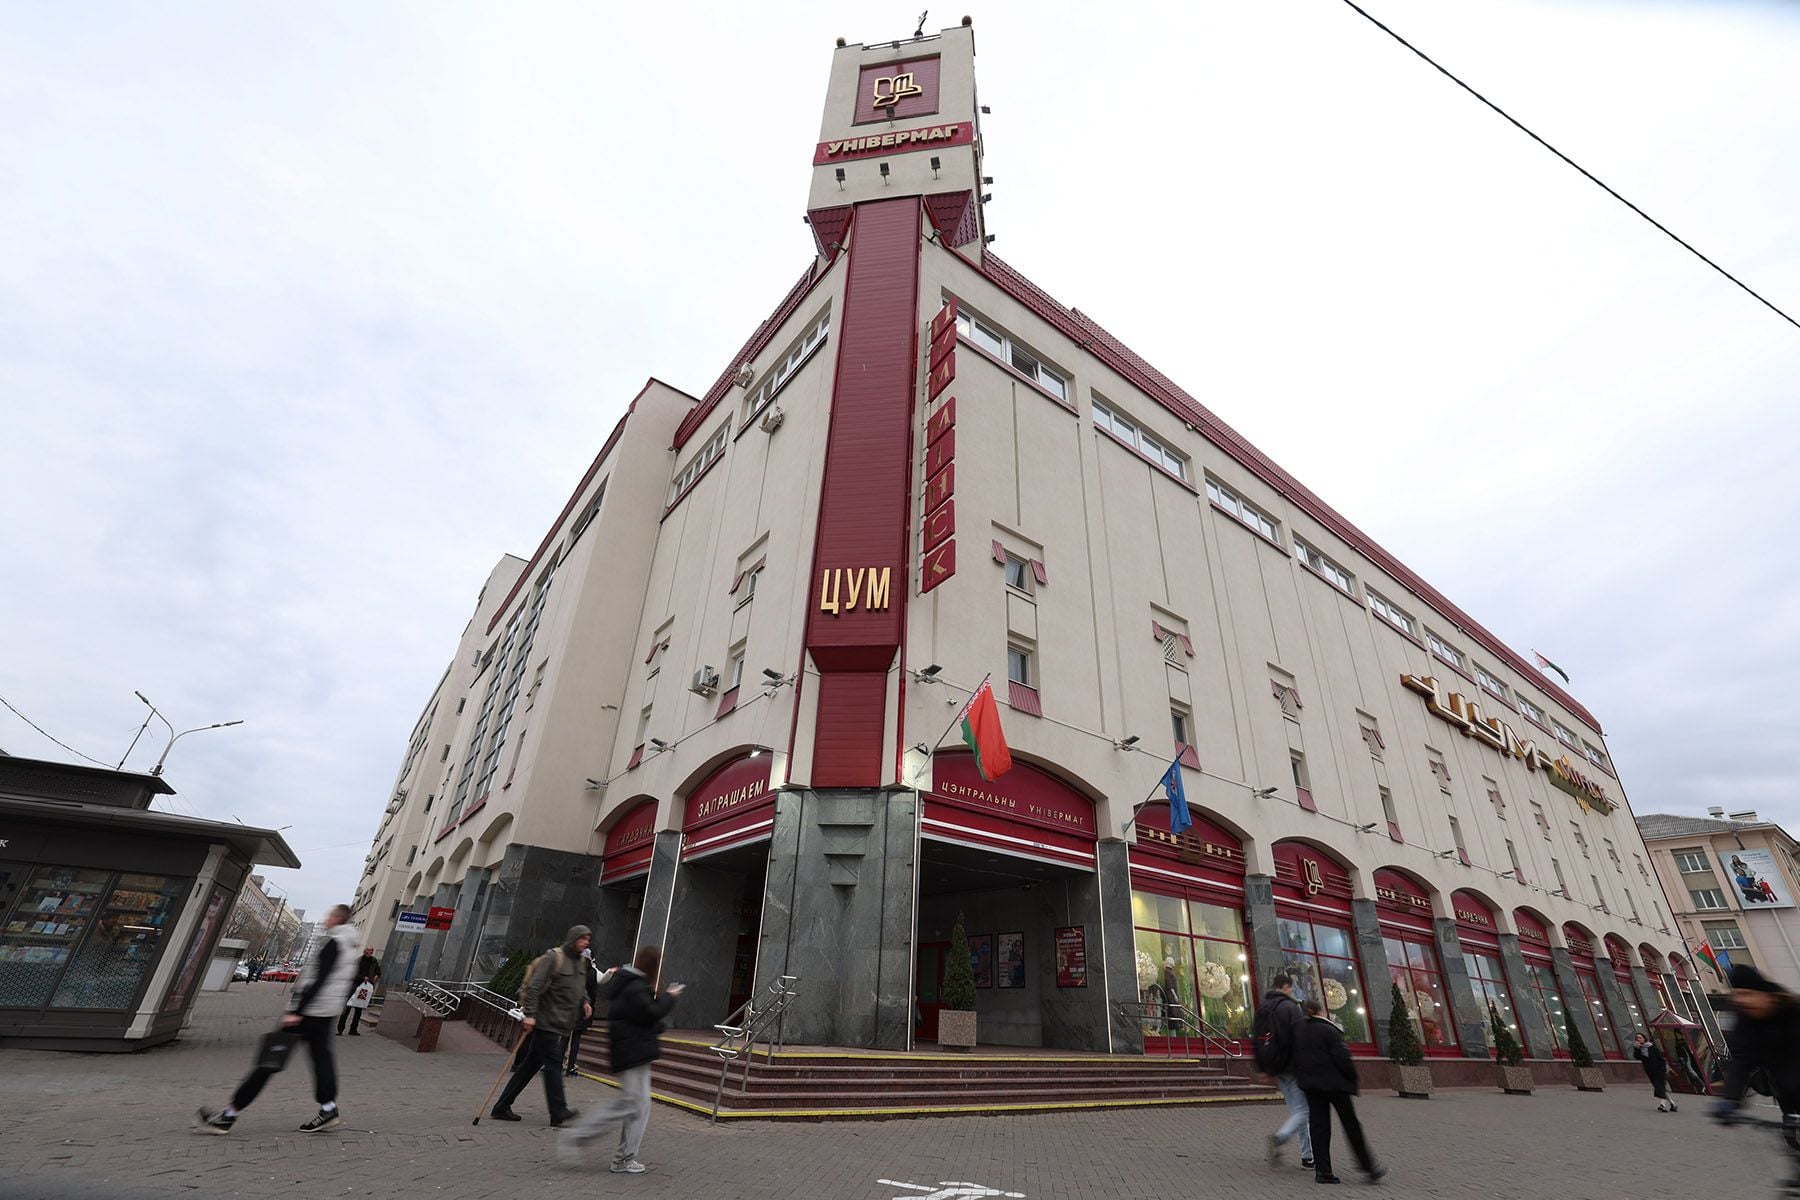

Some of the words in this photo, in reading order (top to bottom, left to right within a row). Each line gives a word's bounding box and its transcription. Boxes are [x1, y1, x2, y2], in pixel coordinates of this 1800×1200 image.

[827, 125, 959, 156] УНІВЕРМАГ
[820, 567, 891, 615] ЦУМ
[698, 779, 764, 817] ЗАПРАШАЕМ
[941, 781, 1016, 808] ЦЭНТРАЛЬНЫ
[1029, 804, 1083, 825] УНІВЕРМАГ
